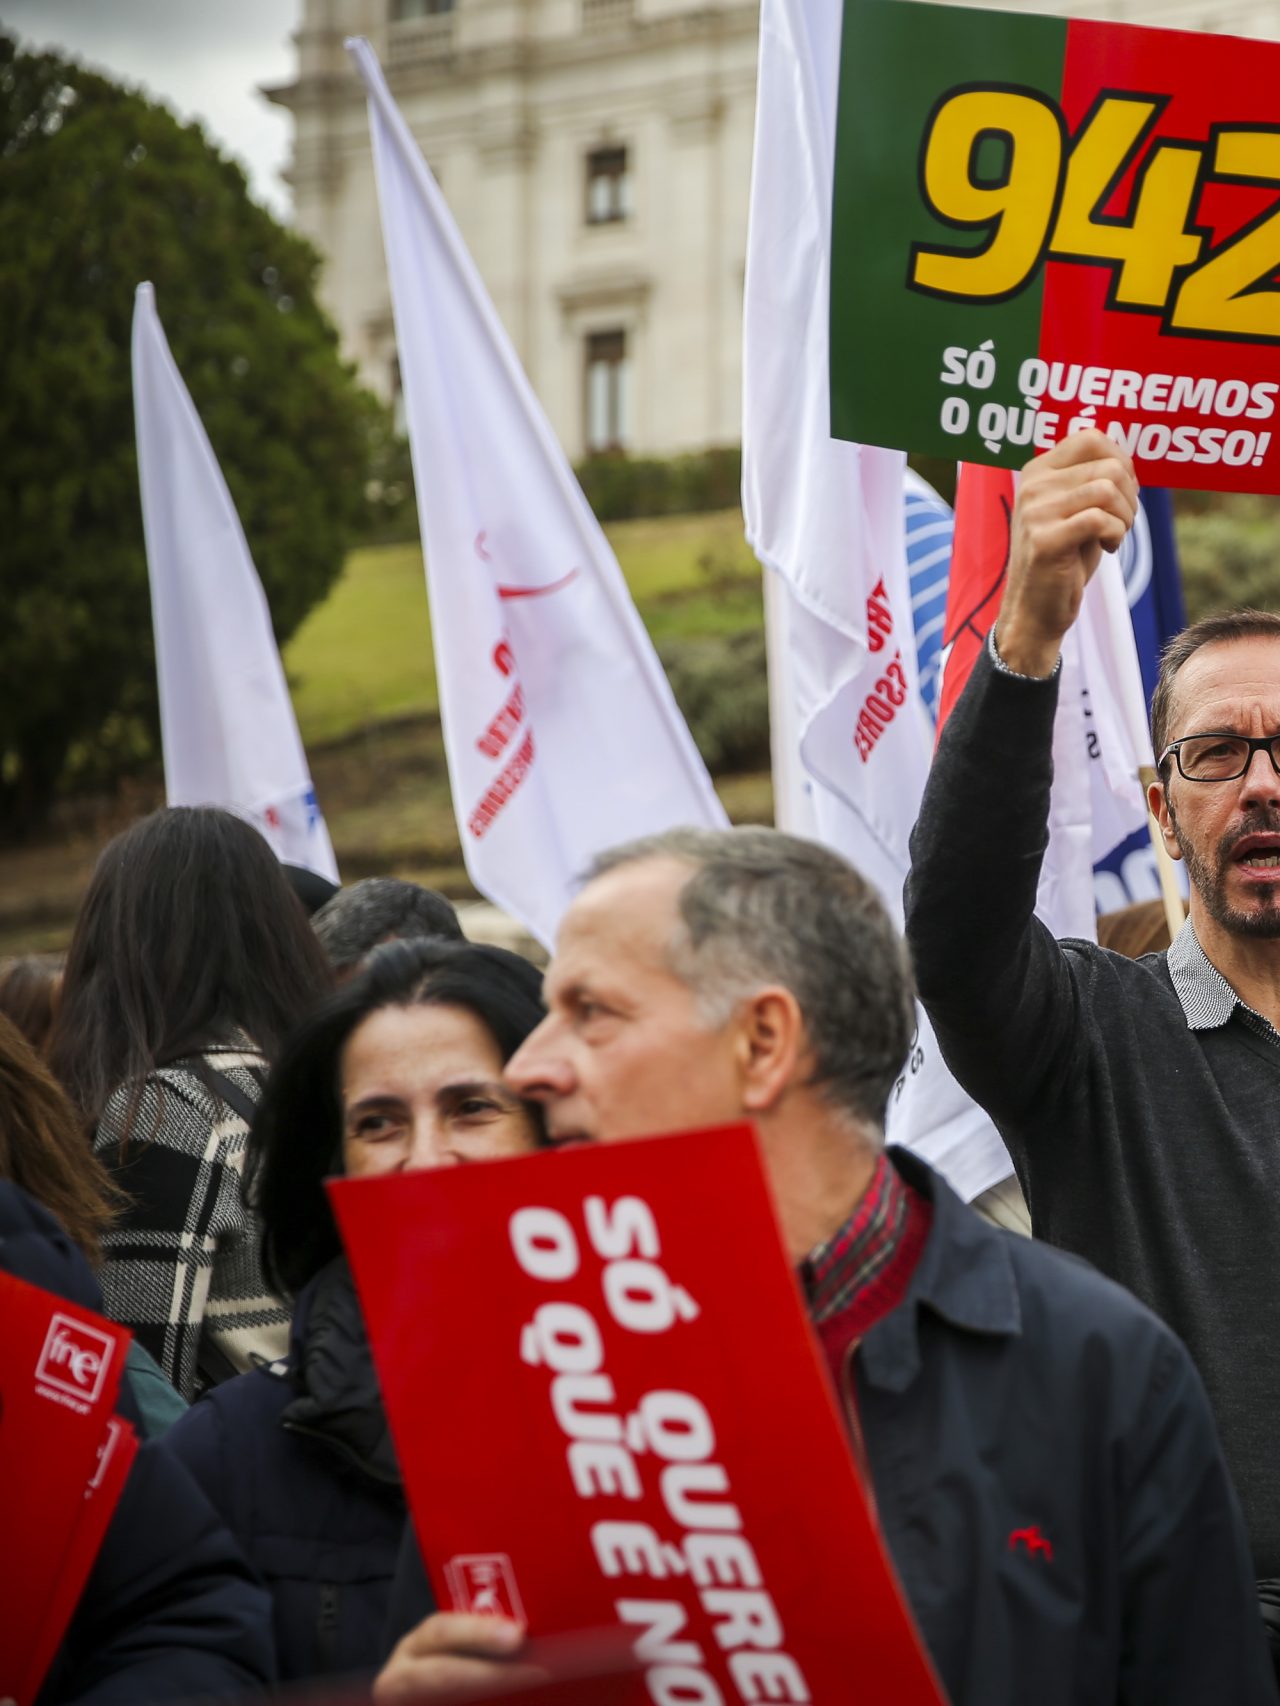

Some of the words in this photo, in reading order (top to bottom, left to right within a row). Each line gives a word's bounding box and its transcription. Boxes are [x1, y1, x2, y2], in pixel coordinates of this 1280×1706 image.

[940, 339, 995, 390] SÓ
[1018, 358, 1280, 420] QUEREMOS
[940, 397, 970, 435] O
[978, 402, 1060, 454] QUE
[1105, 421, 1272, 467] NOSSO!
[509, 1207, 580, 1281] O
[583, 1196, 699, 1333] SÓ
[50, 1329, 101, 1385] fne
[520, 1302, 643, 1500] QUE
[590, 1521, 686, 1578] É
